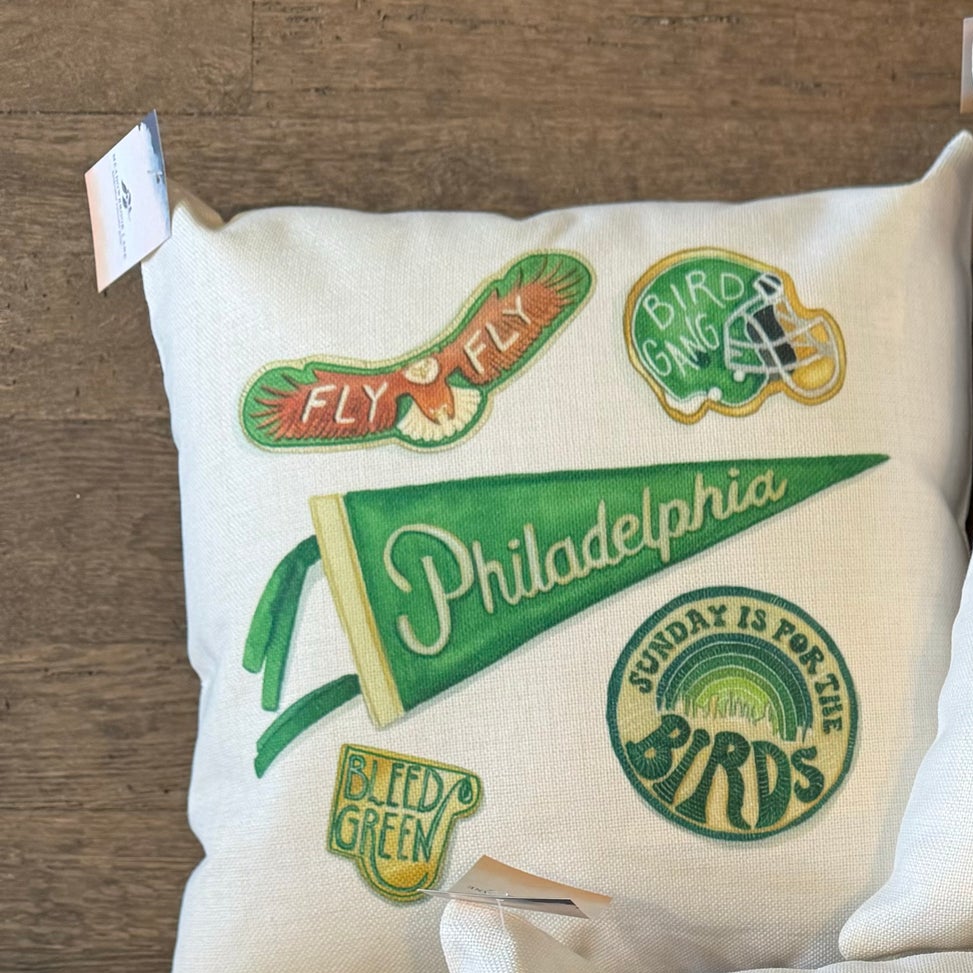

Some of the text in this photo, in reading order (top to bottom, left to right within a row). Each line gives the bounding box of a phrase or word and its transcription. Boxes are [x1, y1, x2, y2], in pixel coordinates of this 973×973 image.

[463, 296, 531, 375] FLY
[643, 270, 745, 330] BIRD
[642, 313, 720, 377] GANG
[302, 382, 388, 424] FLY
[383, 469, 788, 655] Philadelphia
[628, 604, 843, 735] SUNDAY IS FOR THE
[343, 754, 444, 813] BLEED
[625, 714, 825, 830] BIRDS
[333, 802, 446, 880] GREEN
